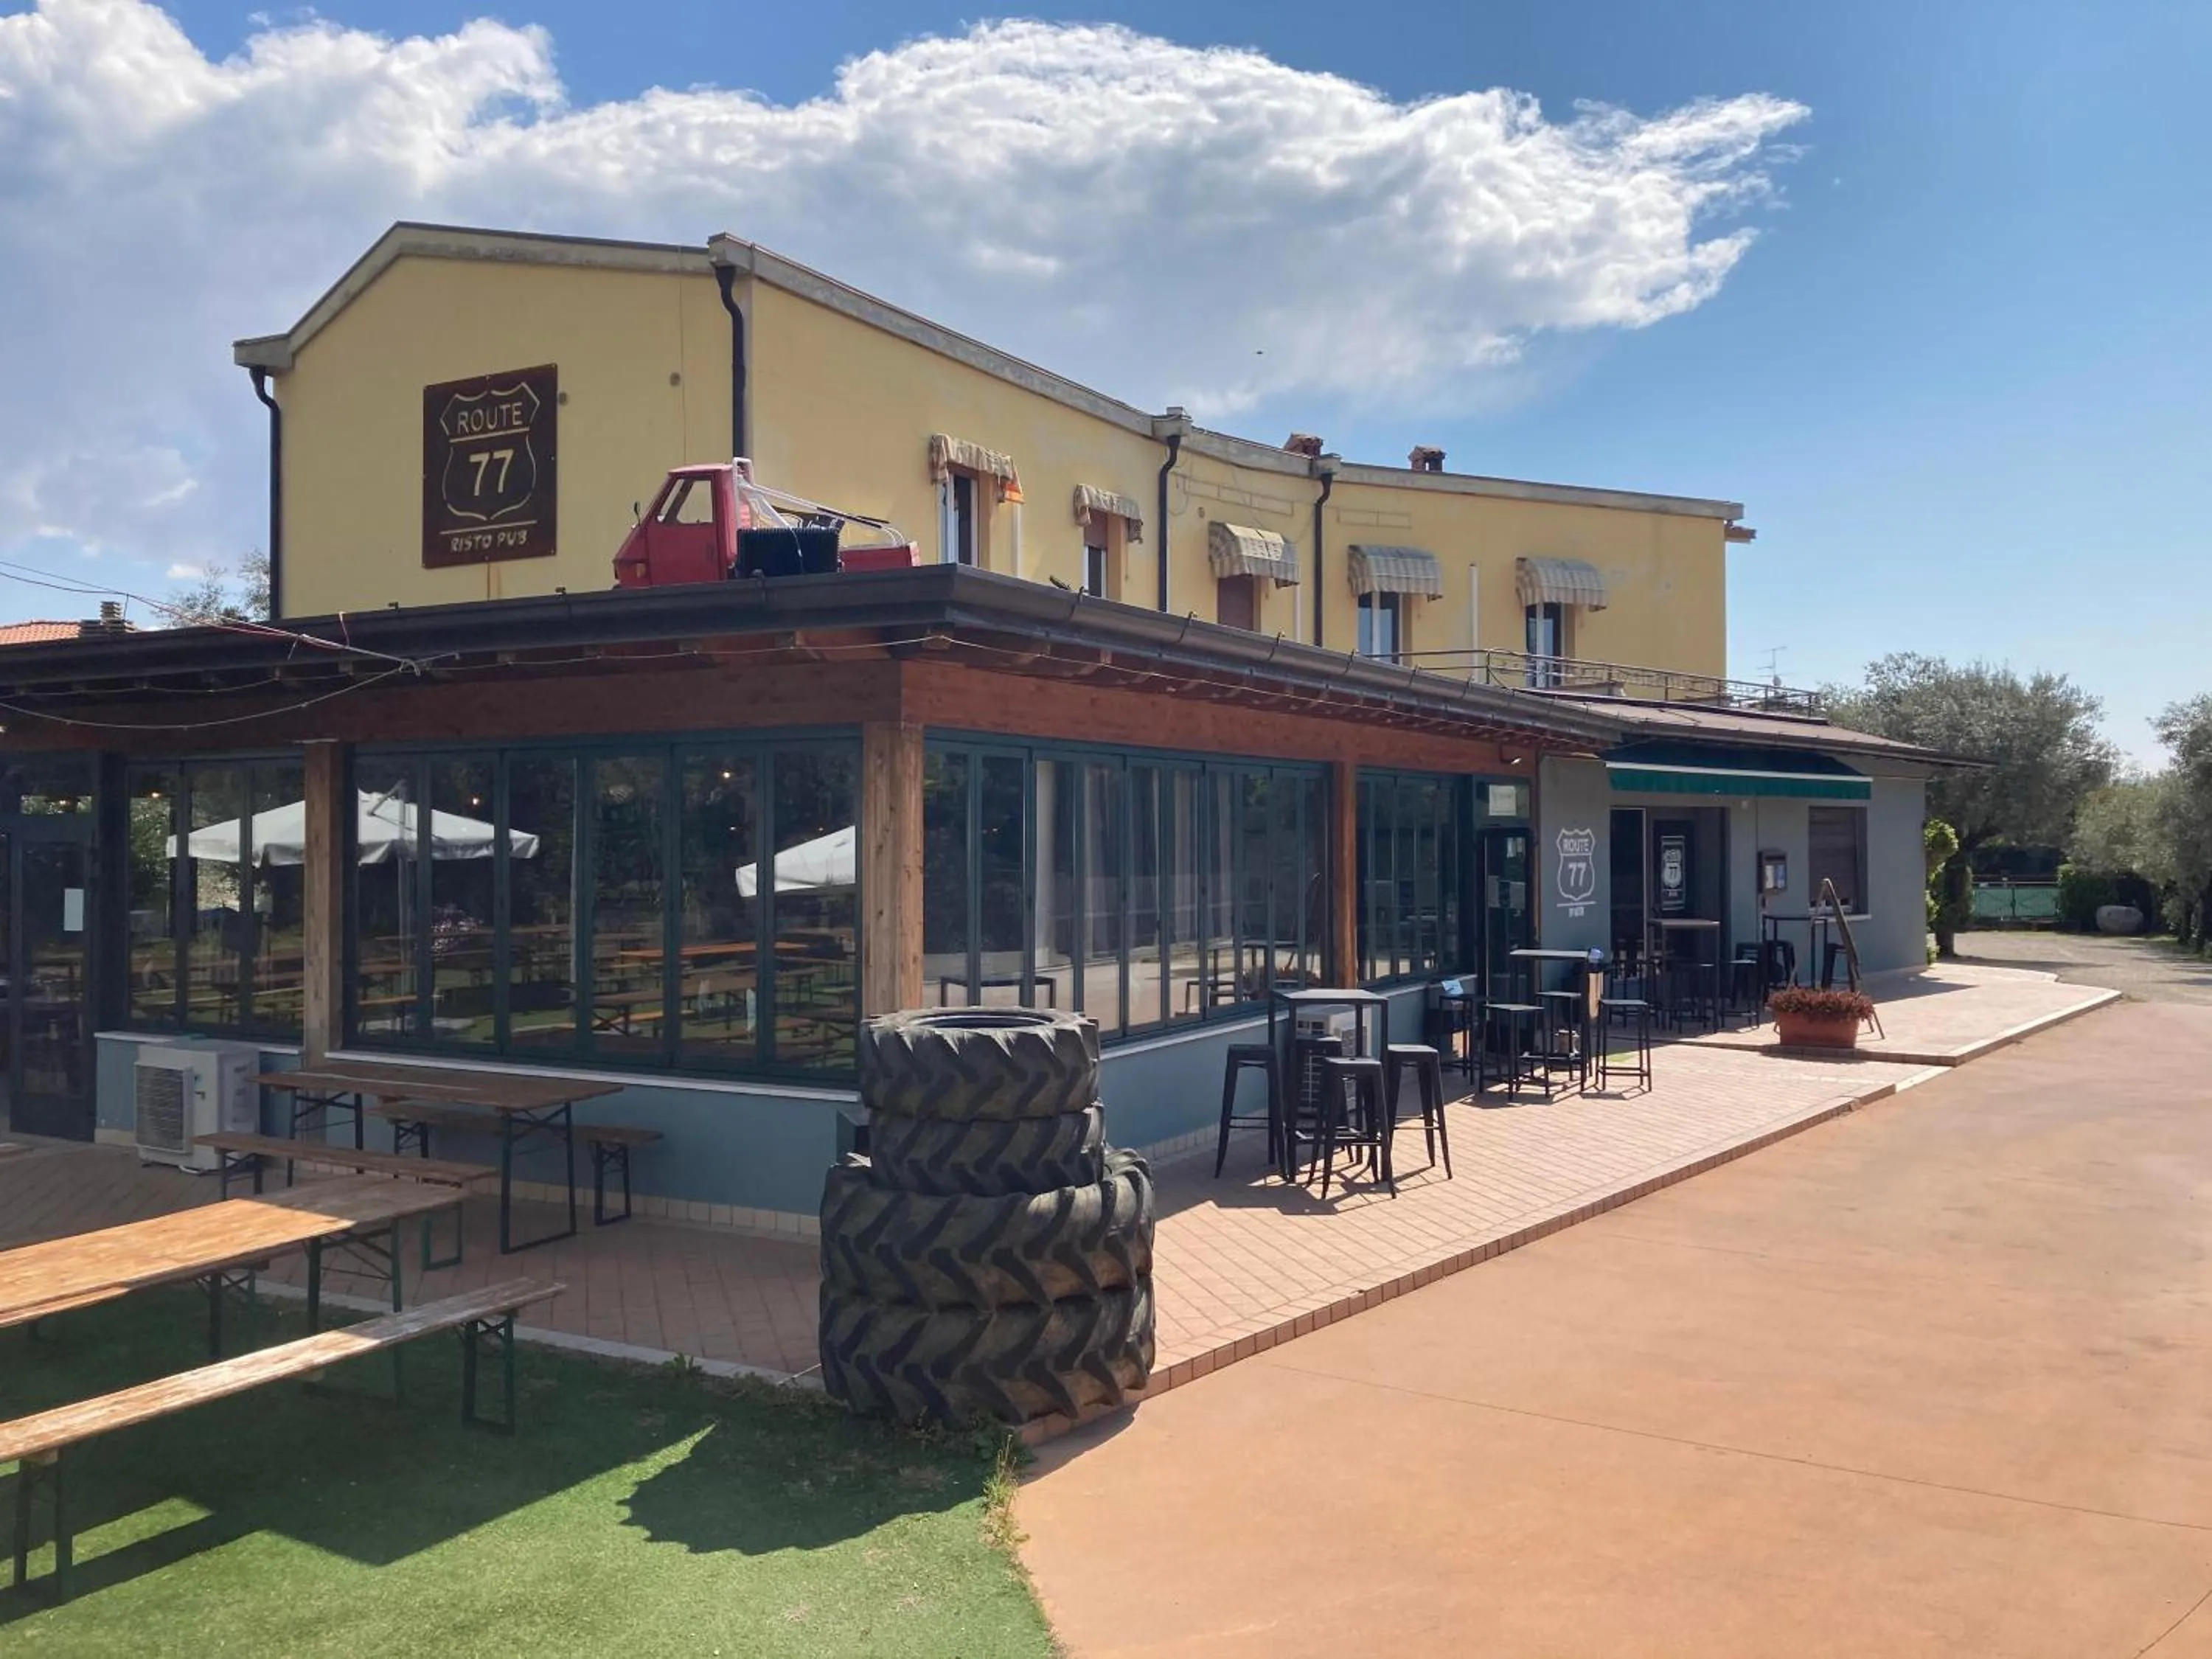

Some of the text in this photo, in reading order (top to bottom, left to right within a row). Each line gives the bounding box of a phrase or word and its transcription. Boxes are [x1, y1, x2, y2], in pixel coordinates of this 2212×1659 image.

[456, 403, 523, 434] ROUTE
[470, 448, 514, 496] 77
[451, 530, 528, 552] RISTO PUB
[1563, 838, 1589, 852] ROUTE
[1568, 862, 1587, 887] 77
